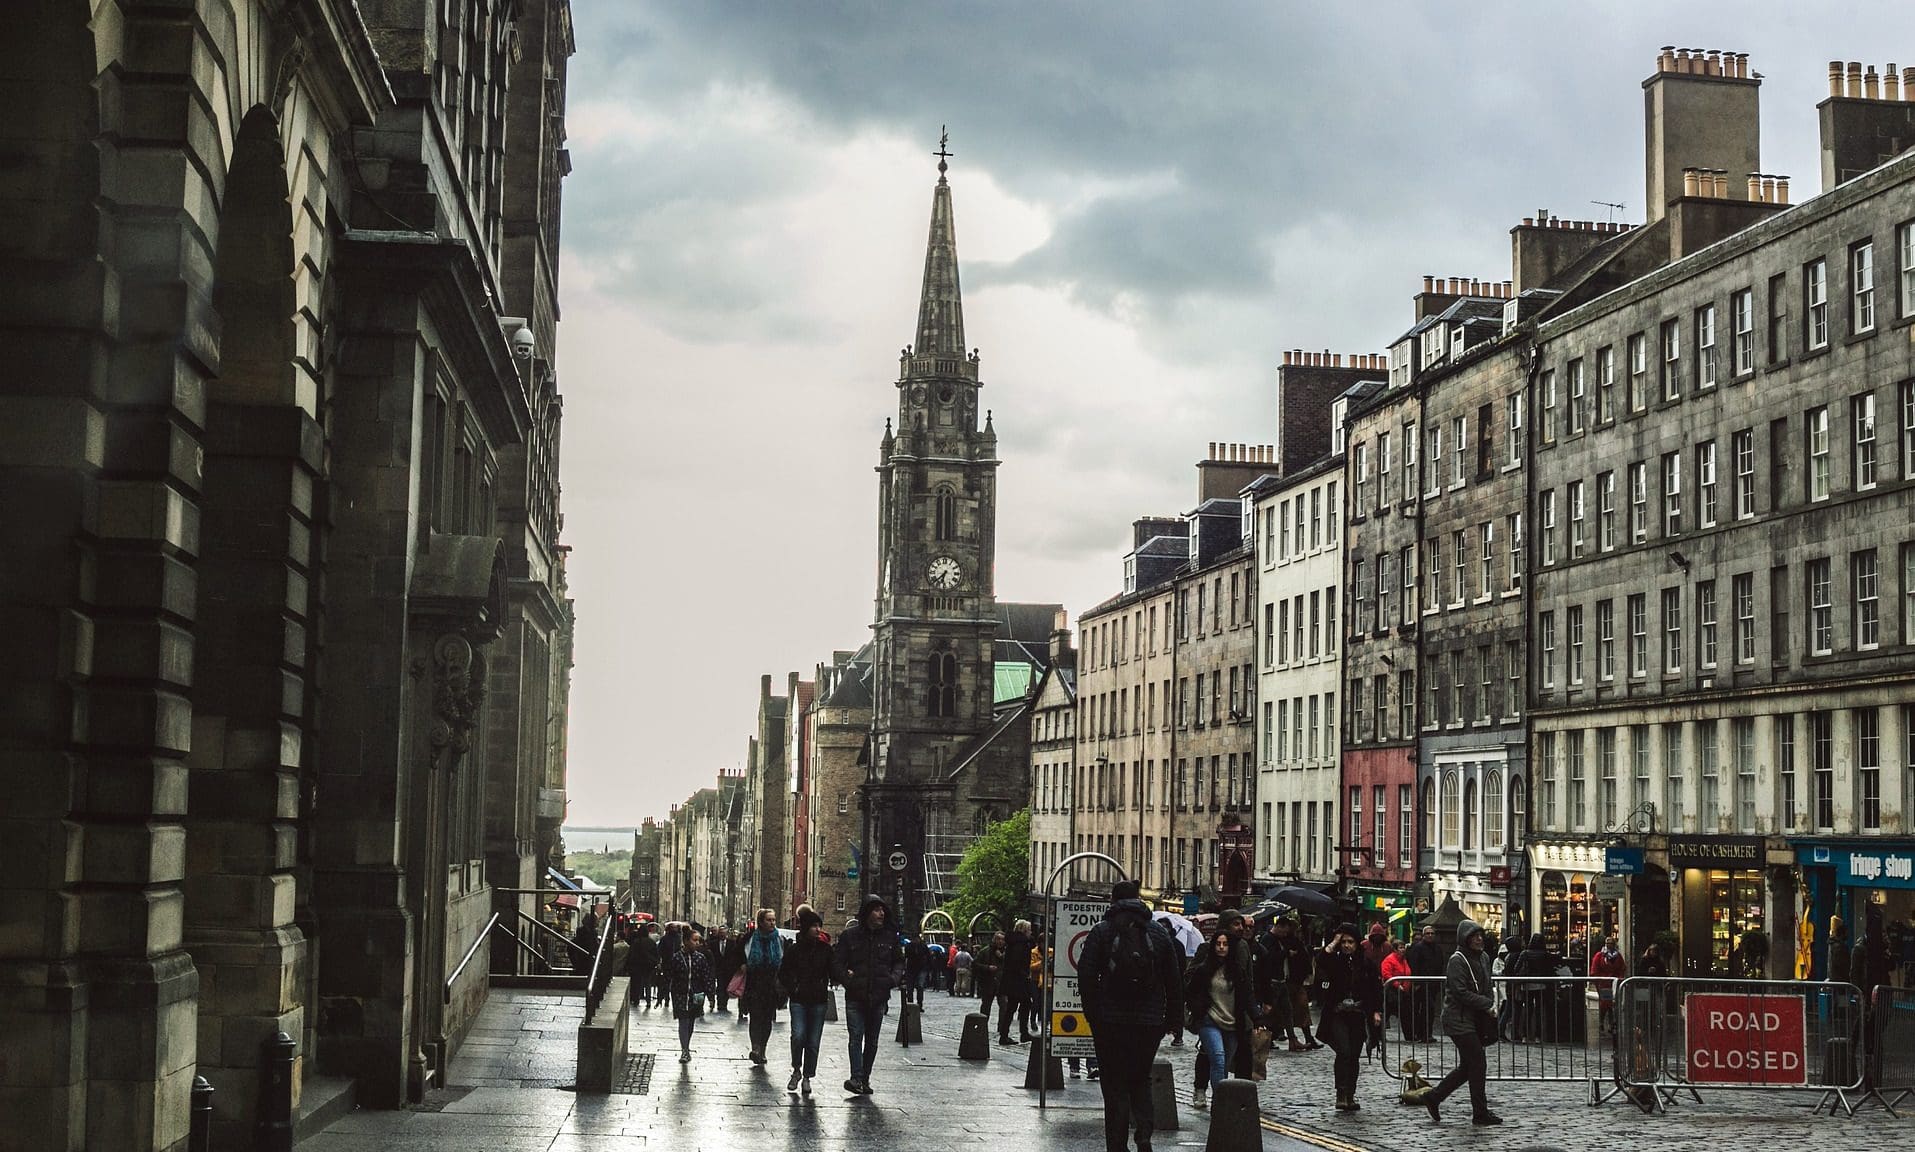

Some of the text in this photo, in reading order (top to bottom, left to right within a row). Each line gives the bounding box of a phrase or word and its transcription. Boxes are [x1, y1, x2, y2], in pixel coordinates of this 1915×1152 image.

[1671, 843, 1757, 858] HOUSE OF CASHMERE
[1850, 852, 1912, 880] fringe shop
[1710, 1011, 1780, 1031] ROAD
[1693, 1049, 1799, 1070] CLOSED
